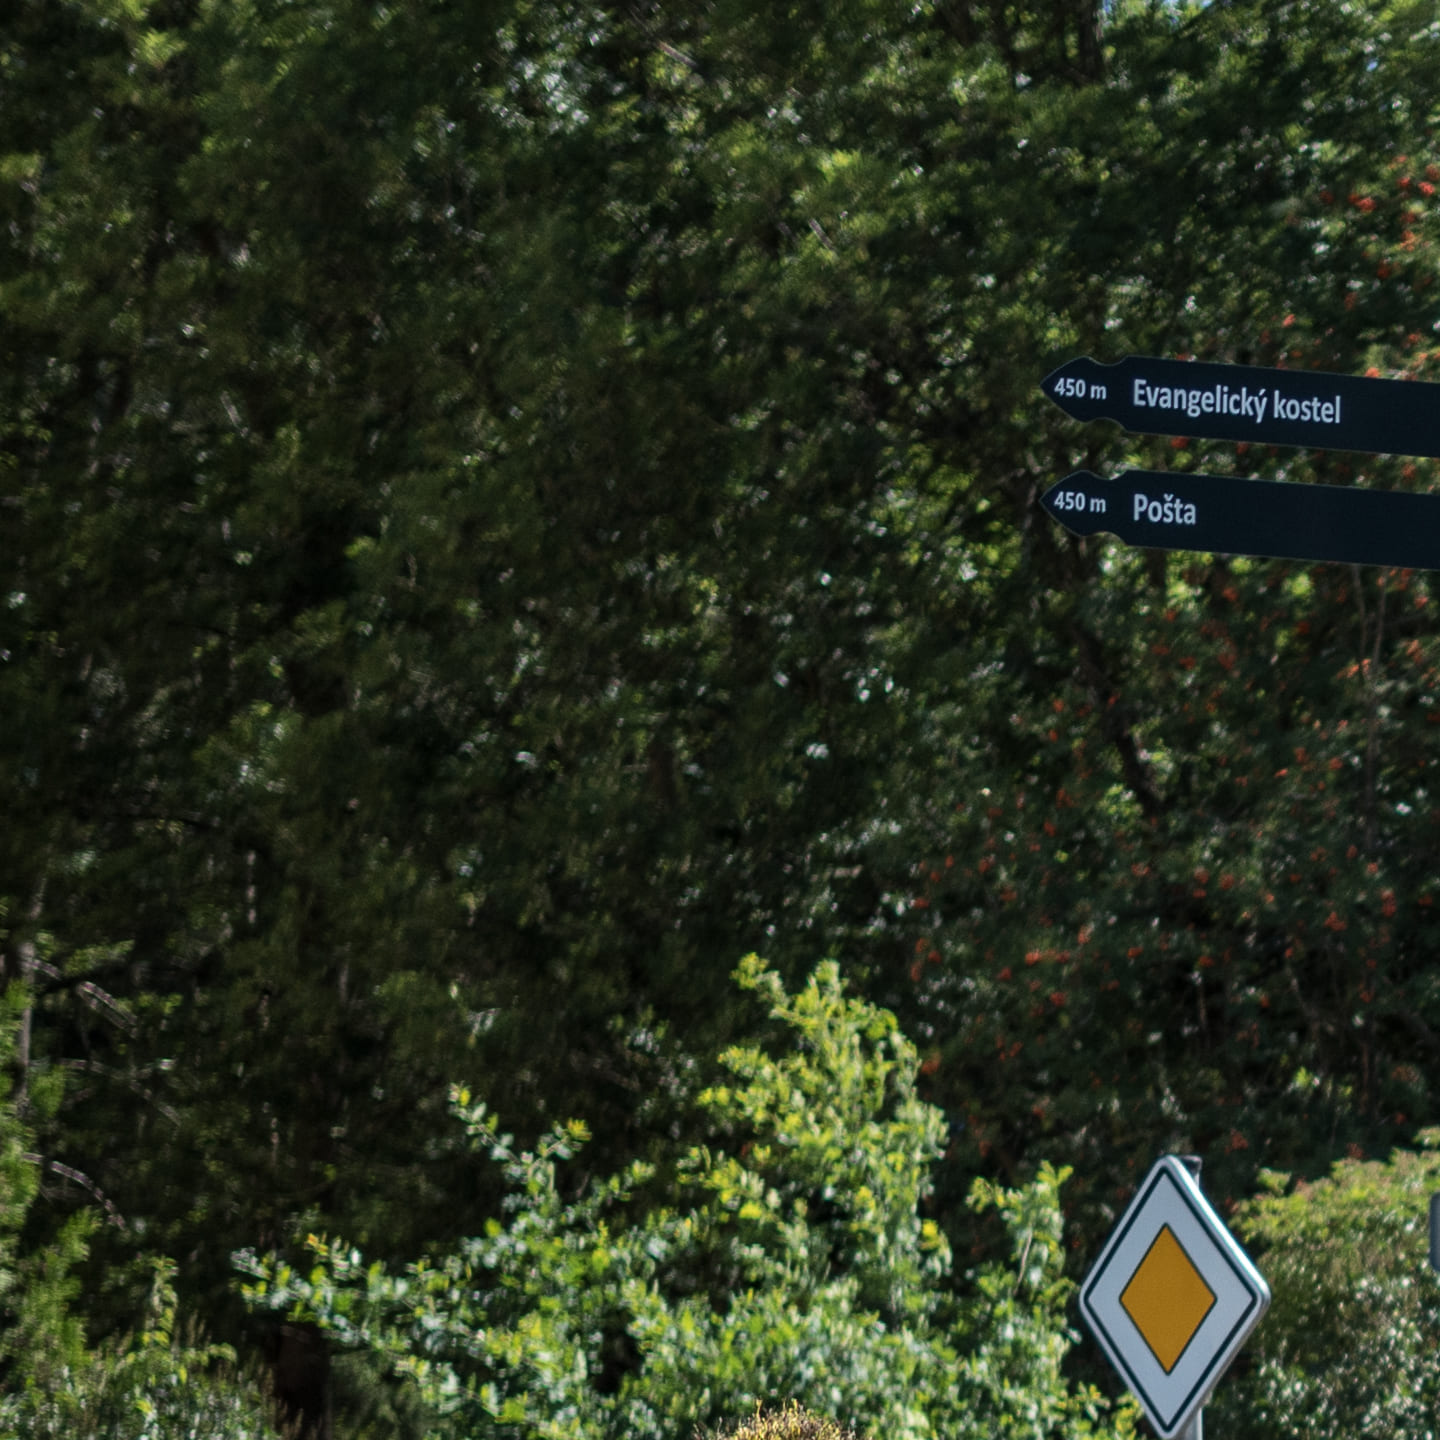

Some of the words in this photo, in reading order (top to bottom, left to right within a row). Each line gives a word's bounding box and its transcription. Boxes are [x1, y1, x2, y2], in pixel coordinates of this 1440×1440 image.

[1054, 378, 1086, 398] 450
[1090, 385, 1107, 400] m
[1133, 379, 1267, 424] Evangelický
[1273, 390, 1341, 424] kostel
[1054, 491, 1086, 512] 450
[1090, 498, 1106, 513] m
[1133, 493, 1197, 525] Pošta
